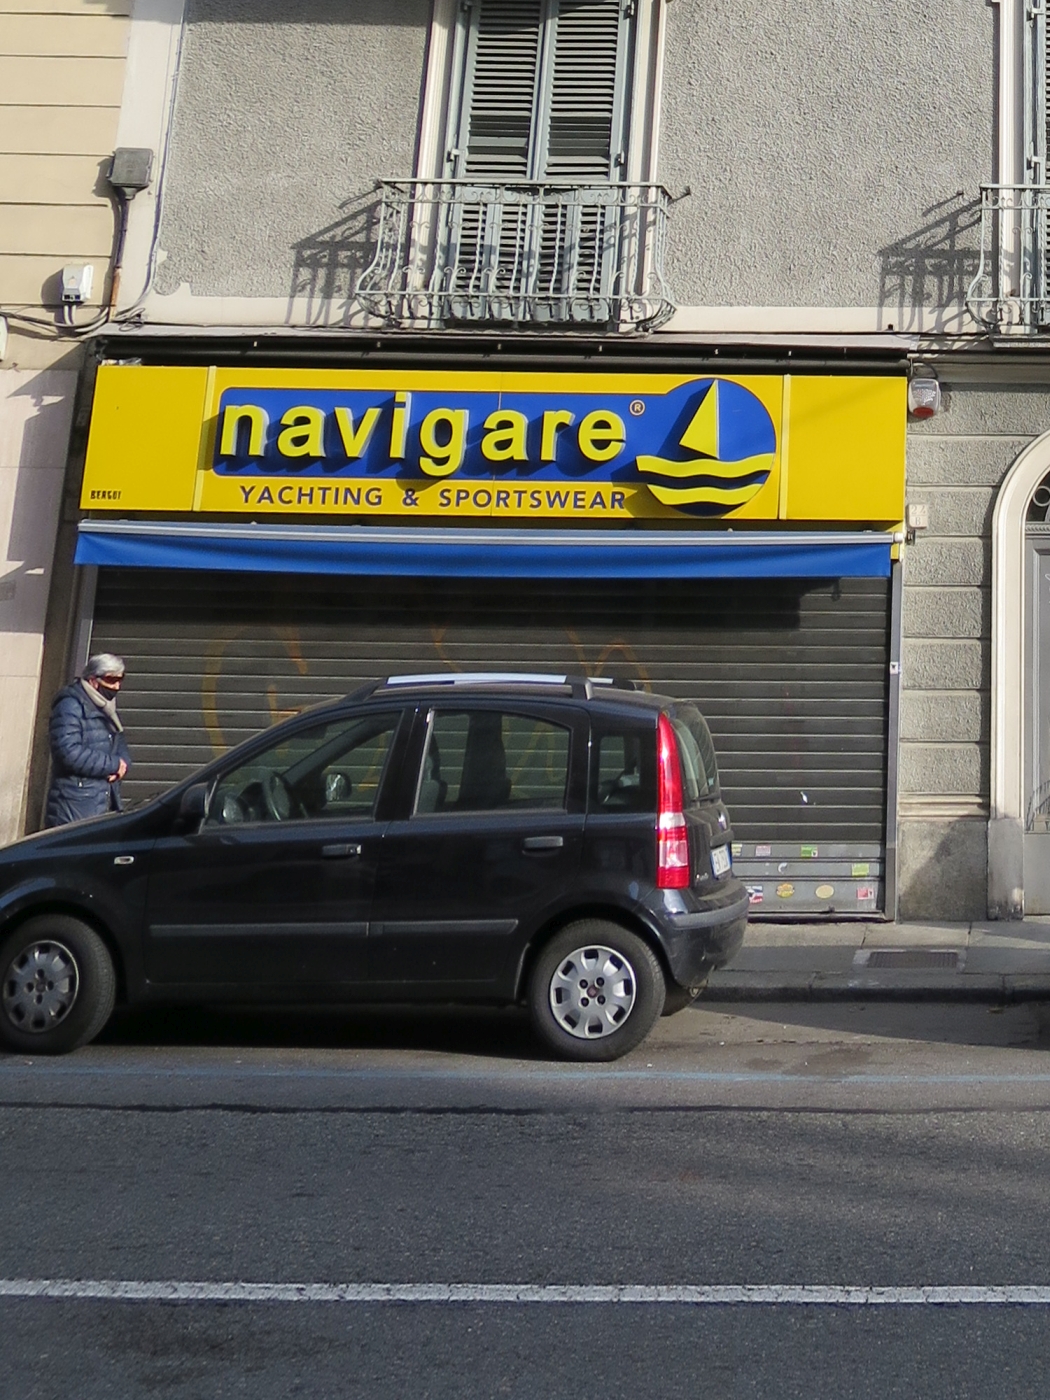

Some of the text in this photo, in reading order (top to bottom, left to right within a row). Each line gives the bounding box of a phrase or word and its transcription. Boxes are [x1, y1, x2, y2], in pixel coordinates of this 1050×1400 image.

[219, 391, 627, 477] navigare
[239, 485, 626, 510] YACHTING & SPORTSWEAR
